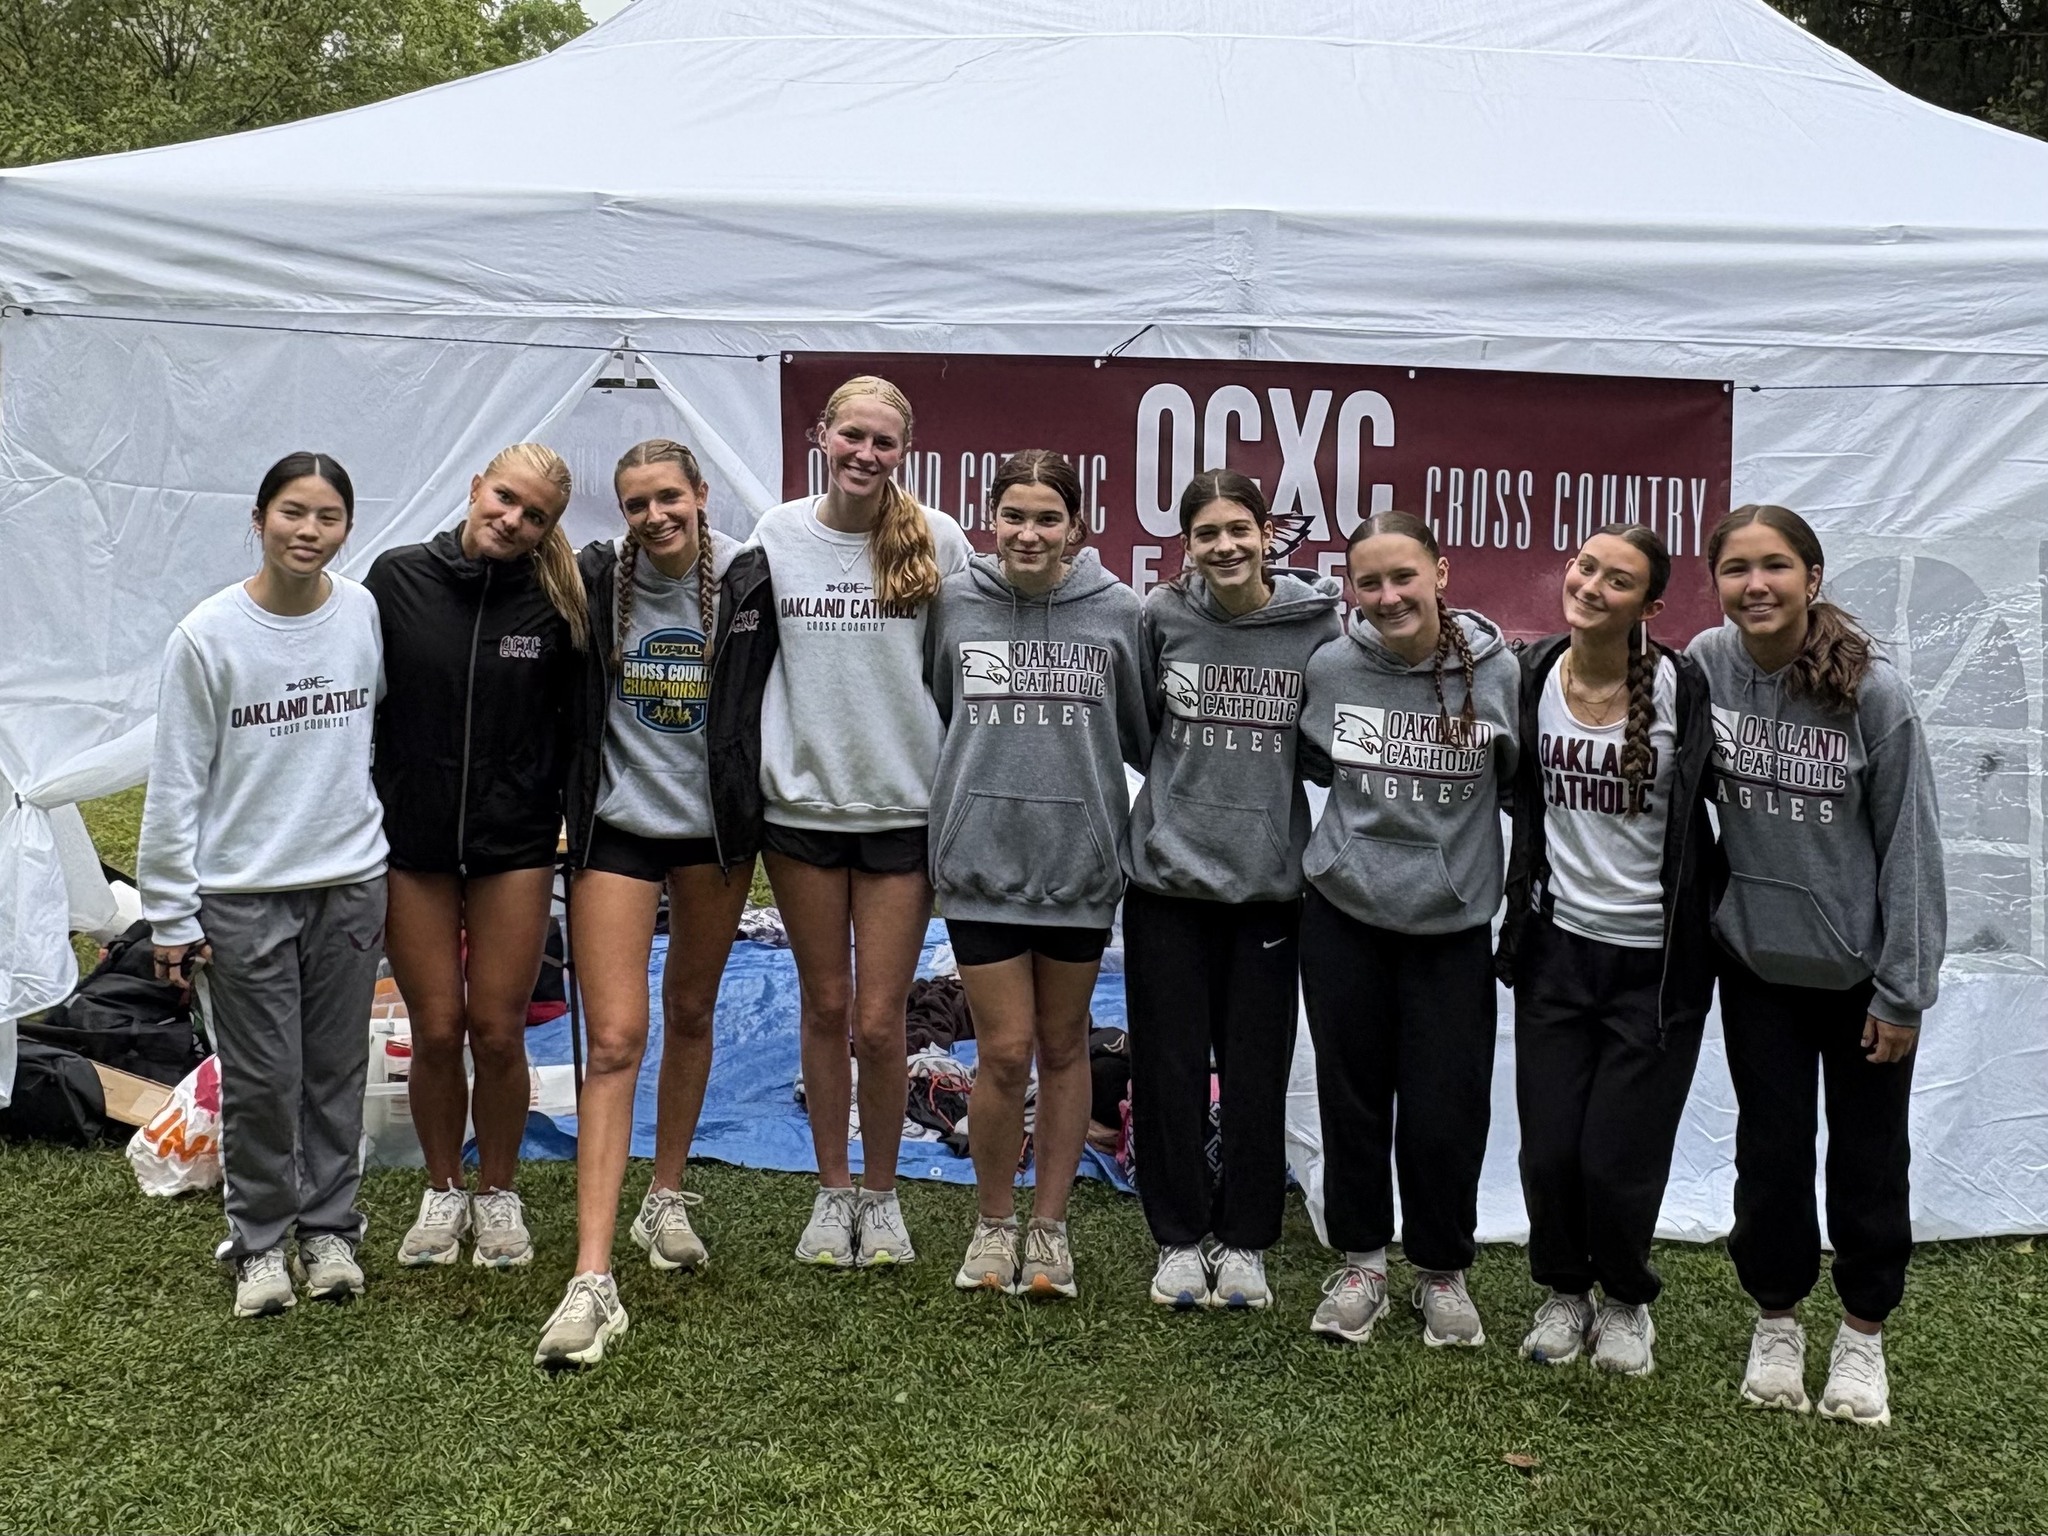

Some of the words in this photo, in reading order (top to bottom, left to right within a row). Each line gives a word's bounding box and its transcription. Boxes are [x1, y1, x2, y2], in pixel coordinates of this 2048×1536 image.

[1136, 383, 1395, 541] OCXC
[1425, 466, 1533, 550] CROSS
[1554, 472, 1707, 556] COUNTRY
[781, 598, 845, 618] OAKLAND
[623, 662, 665, 680] CROSS
[667, 664, 712, 683] COUNT
[1013, 640, 1110, 675] OAKLAND
[1012, 670, 1106, 698] CATHOLIC
[1203, 664, 1302, 699] OAKLAND
[231, 696, 307, 728] OAKLAND
[967, 703, 1091, 727] EAGLES
[1202, 694, 1298, 723] CATHOLIC
[1384, 742, 1487, 773] CATHOLIC
[1541, 733, 1658, 780] OAKLAD
[1543, 769, 1654, 815] CATHOLC
[1716, 780, 1833, 823] AGLES
